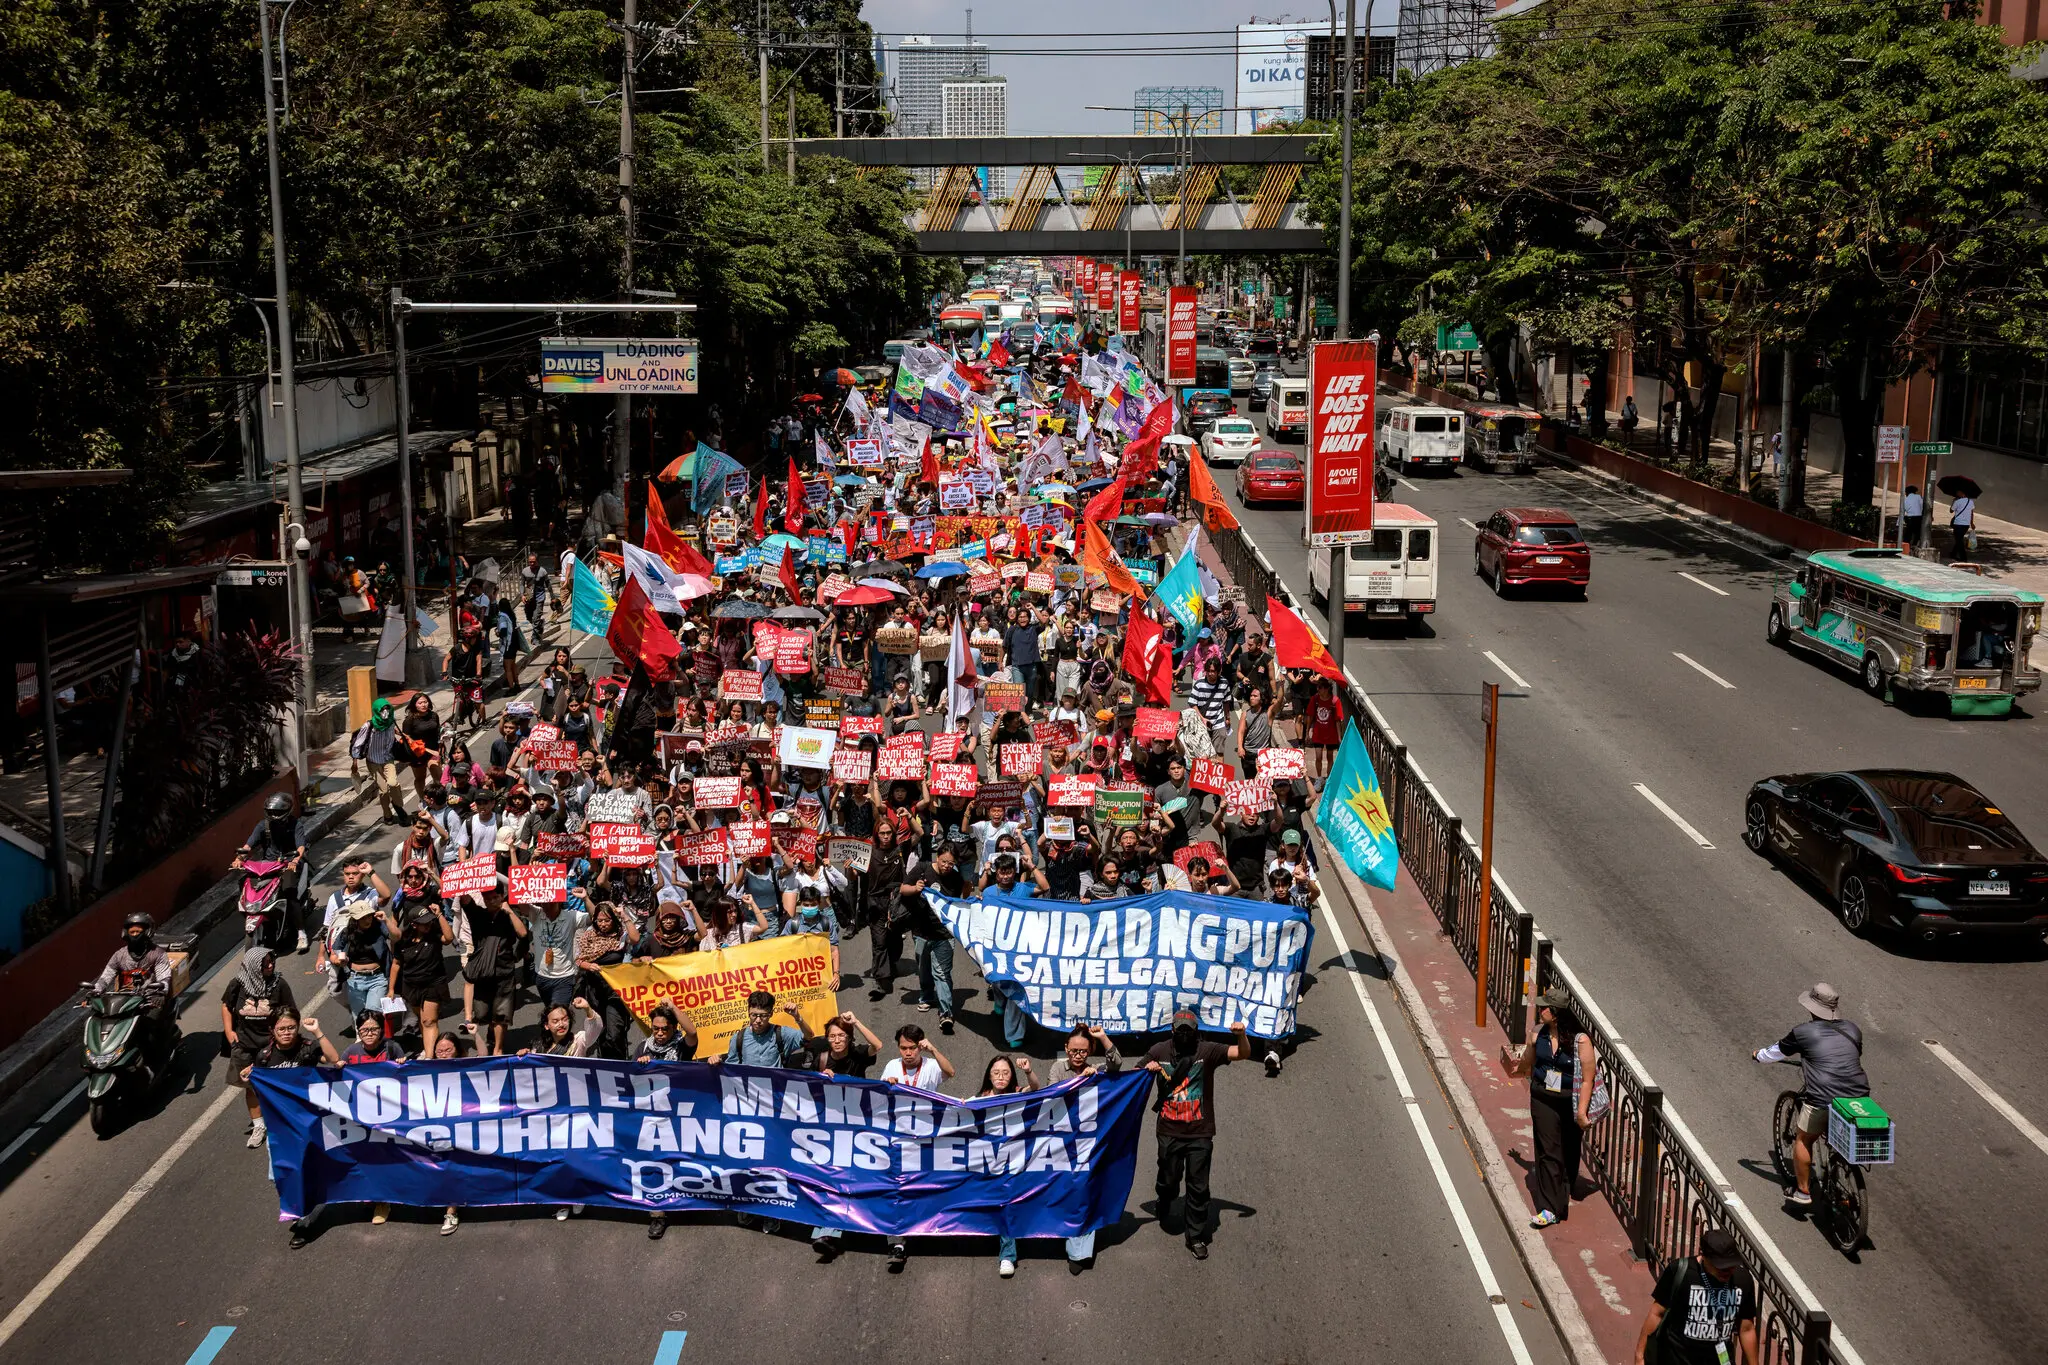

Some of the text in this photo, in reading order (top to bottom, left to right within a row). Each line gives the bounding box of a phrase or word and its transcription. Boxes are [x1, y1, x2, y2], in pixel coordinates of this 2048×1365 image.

[1264, 57, 1281, 67] Kung
[1269, 70, 1292, 82] KA
[1174, 302, 1194, 314] KEEP
[616, 344, 685, 358] LOADING
[544, 358, 601, 372] DAVIES
[606, 368, 696, 382] UNLOADING
[619, 384, 638, 392] CITY
[652, 384, 683, 392] MANILA
[1325, 374, 1366, 395] LIFE
[1319, 394, 1369, 415] DOES
[1324, 414, 1364, 434] NOT
[1319, 433, 1368, 454] WAIT
[1329, 468, 1358, 478] MOVE
[861, 722, 881, 731] VAT
[705, 728, 738, 743] SCRAP
[887, 734, 923, 748] PRESYO NG
[534, 741, 575, 751] PRESYO NG
[1001, 743, 1043, 755] EXCISE TAX
[847, 750, 861, 761] VAT
[879, 748, 922, 759] YOUTH FIGHT
[1001, 753, 1042, 765] SA LANGIS
[879, 758, 924, 767] BACK AGAINST
[1195, 761, 1208, 773] NO
[889, 767, 906, 778] PRICE
[907, 767, 922, 777] HIKE
[936, 764, 972, 775] PRESYO NG
[955, 781, 976, 791] BACK!
[1109, 780, 1130, 792] EXTRA
[1208, 774, 1227, 789] VAT!
[590, 792, 614, 802] ANG
[591, 801, 604, 809] AT
[1096, 799, 1142, 809] DEREGULATION
[1225, 804, 1246, 816] SA
[593, 826, 608, 838] OIL
[755, 821, 767, 830] NG
[683, 831, 720, 848] IPRENO
[1330, 797, 1384, 871] KABATAAN
[608, 836, 617, 846] US
[752, 838, 767, 847] ANG
[680, 841, 725, 858] ang taas
[687, 853, 724, 866] PRESYO
[464, 867, 474, 878] SA
[511, 866, 557, 879] 12% VAT
[442, 879, 459, 892] BABY
[511, 880, 527, 893] SA
[527, 877, 567, 891] BILIHIN
[1157, 908, 1221, 960] NG
[1224, 919, 1308, 968] PUP
[652, 955, 827, 998] COMMUNITY JOINS
[755, 970, 823, 994] STRIKE!
[1013, 955, 1055, 985] SA
[1058, 957, 1180, 988] WELGA
[1181, 961, 1284, 1007] LABAN
[694, 1002, 734, 1015] KOMYUTER
[787, 987, 820, 999] MAGKAISA!
[807, 993, 828, 1003] EXCISE
[1064, 986, 1147, 1031] HIKE
[695, 1013, 748, 1029] ANG GIYERANG
[308, 1065, 695, 1124] KOMYUTER,
[321, 1111, 1096, 1175] BAGUHIN ANG SISTEMA!
[620, 1158, 798, 1200] para
[732, 1195, 796, 1208] NETWORK
